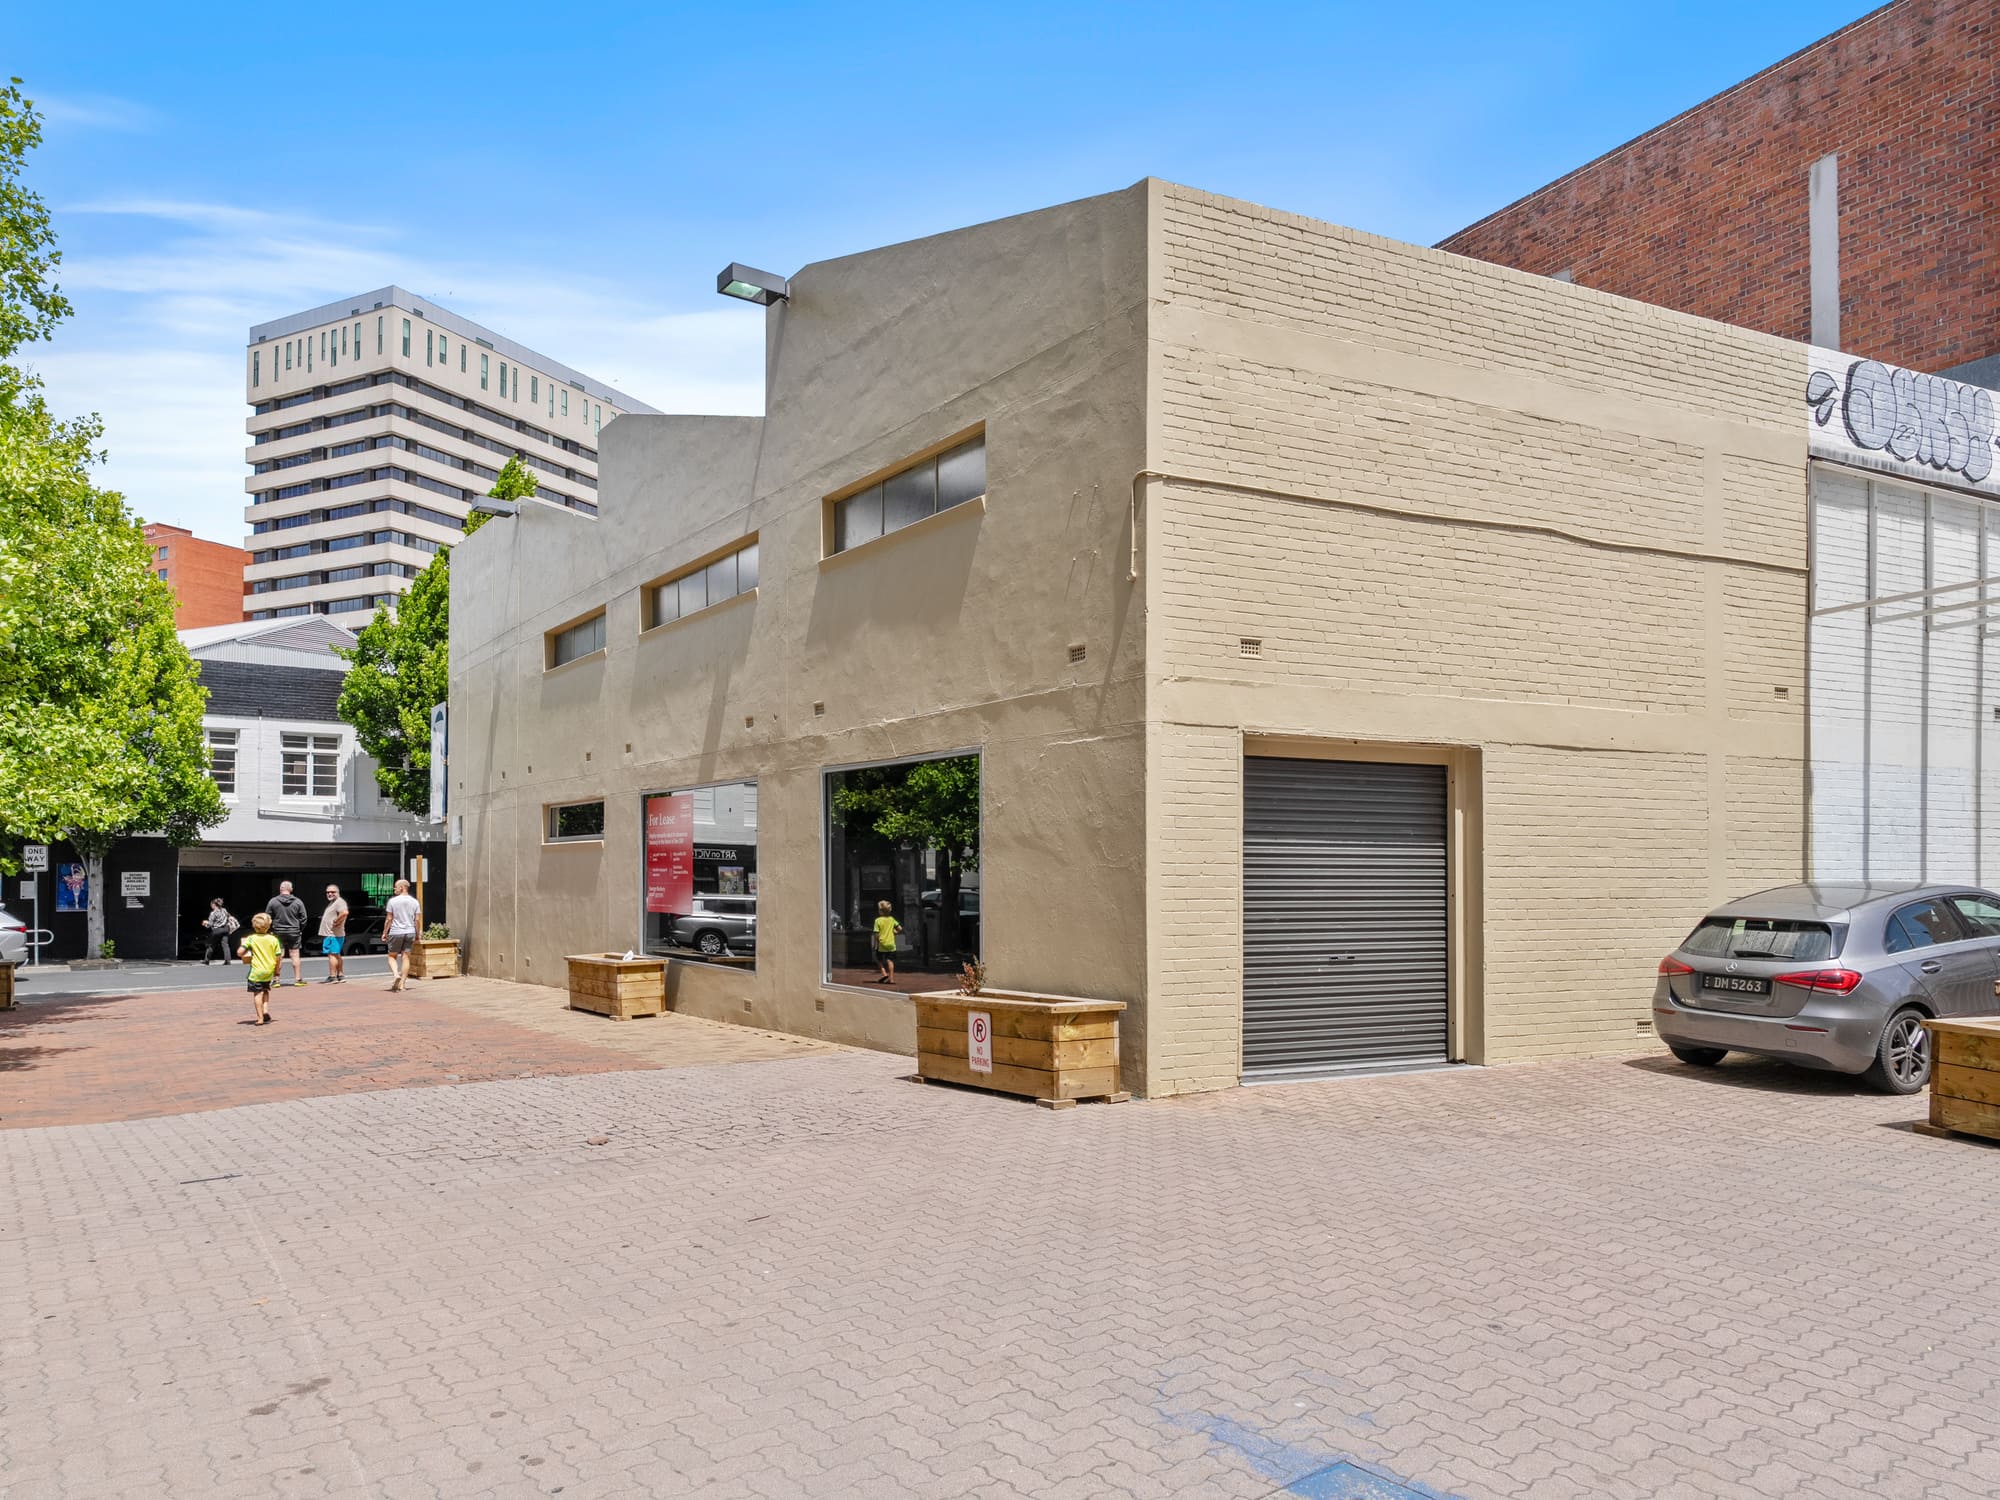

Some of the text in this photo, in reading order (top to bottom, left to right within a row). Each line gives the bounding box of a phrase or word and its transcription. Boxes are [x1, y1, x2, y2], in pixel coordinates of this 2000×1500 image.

[649, 813, 675, 826] For Lease
[1713, 976, 1729, 989] DM
[1731, 978, 1762, 993] 5263
